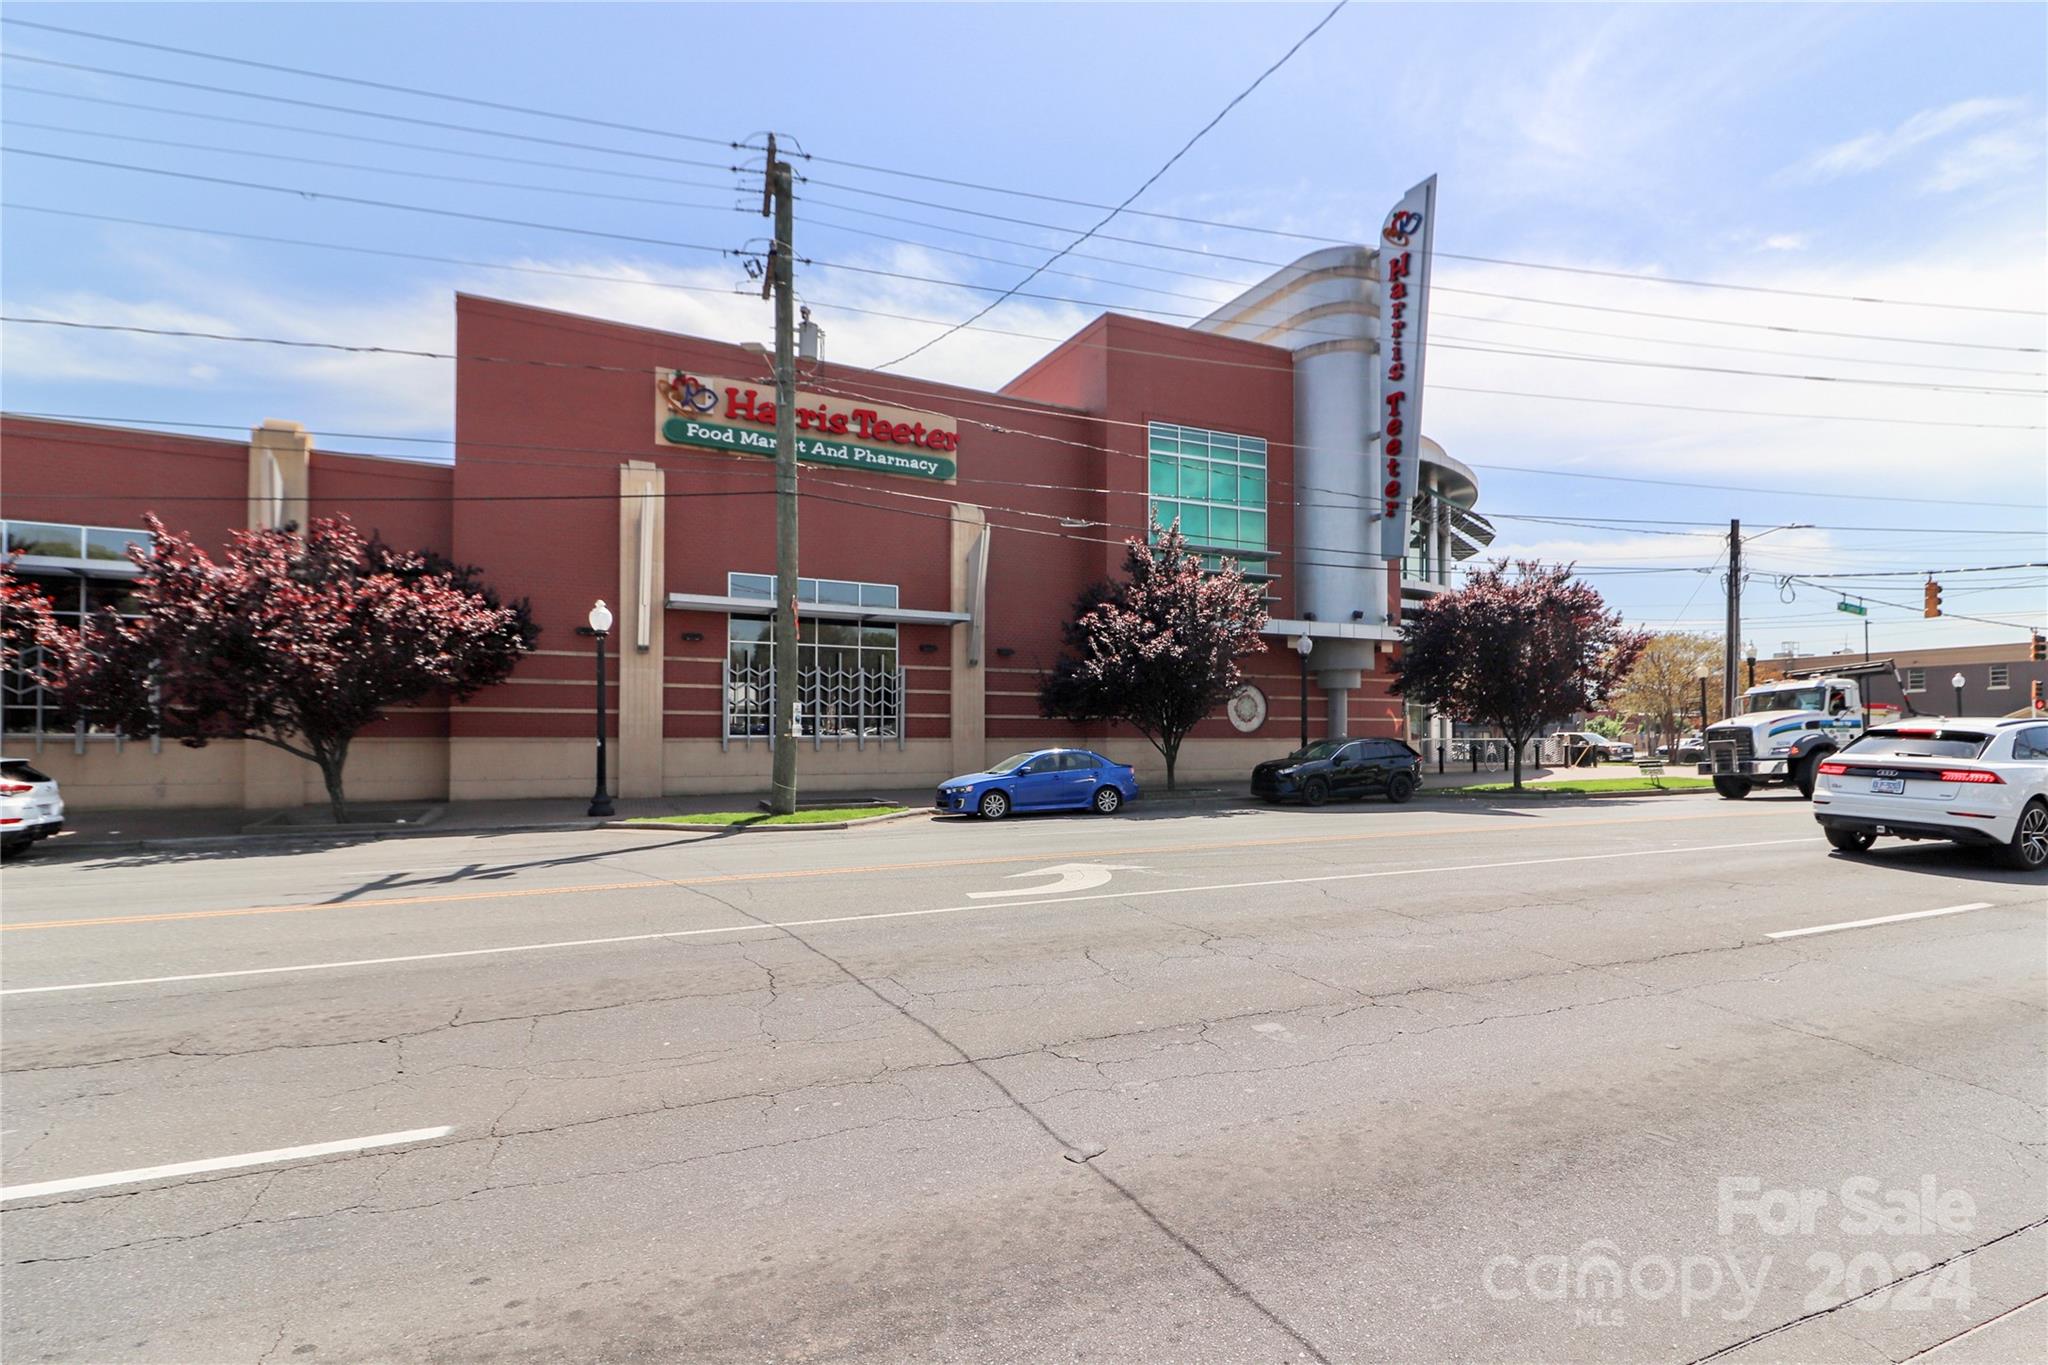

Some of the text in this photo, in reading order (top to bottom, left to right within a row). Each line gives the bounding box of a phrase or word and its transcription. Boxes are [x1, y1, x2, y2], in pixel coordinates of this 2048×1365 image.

[1385, 252, 1410, 518] Harris Teeter
[686, 423, 938, 474] Food Mart And Pharmacy
[725, 387, 960, 451] Haris Teeter
